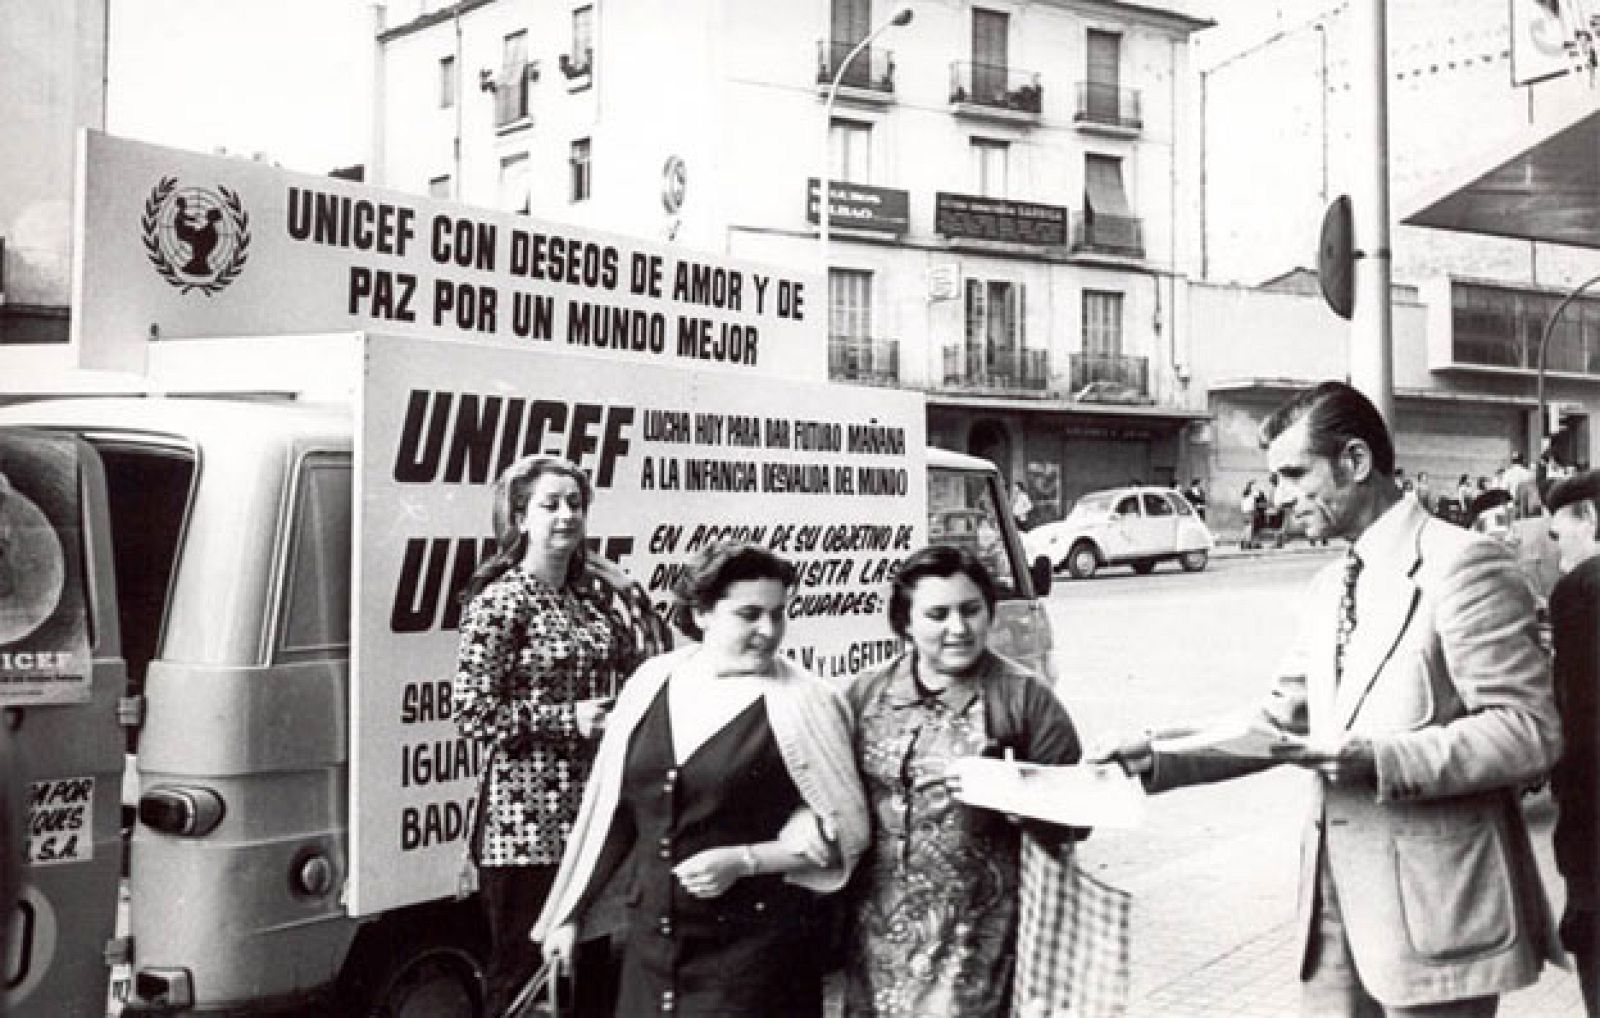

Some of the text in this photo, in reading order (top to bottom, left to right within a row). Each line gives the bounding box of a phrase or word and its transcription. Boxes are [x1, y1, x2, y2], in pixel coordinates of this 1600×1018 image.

[287, 186, 804, 320] UNICEF CON DESEOS DE AMOR Y DE
[349, 266, 759, 367] PAZ POR UN MUNDO MEJOR
[393, 389, 636, 488] UNICEF
[643, 409, 906, 456] LUCHA HOY PARA DAR FUTURO MAÑANA
[641, 456, 909, 498] A LA INFANCIA DESVALIDA DEL MUNDO
[649, 524, 683, 554] EN
[768, 524, 796, 552] DE
[796, 524, 821, 552] SU
[822, 524, 893, 552] OBJETIVO
[894, 524, 914, 551] DE
